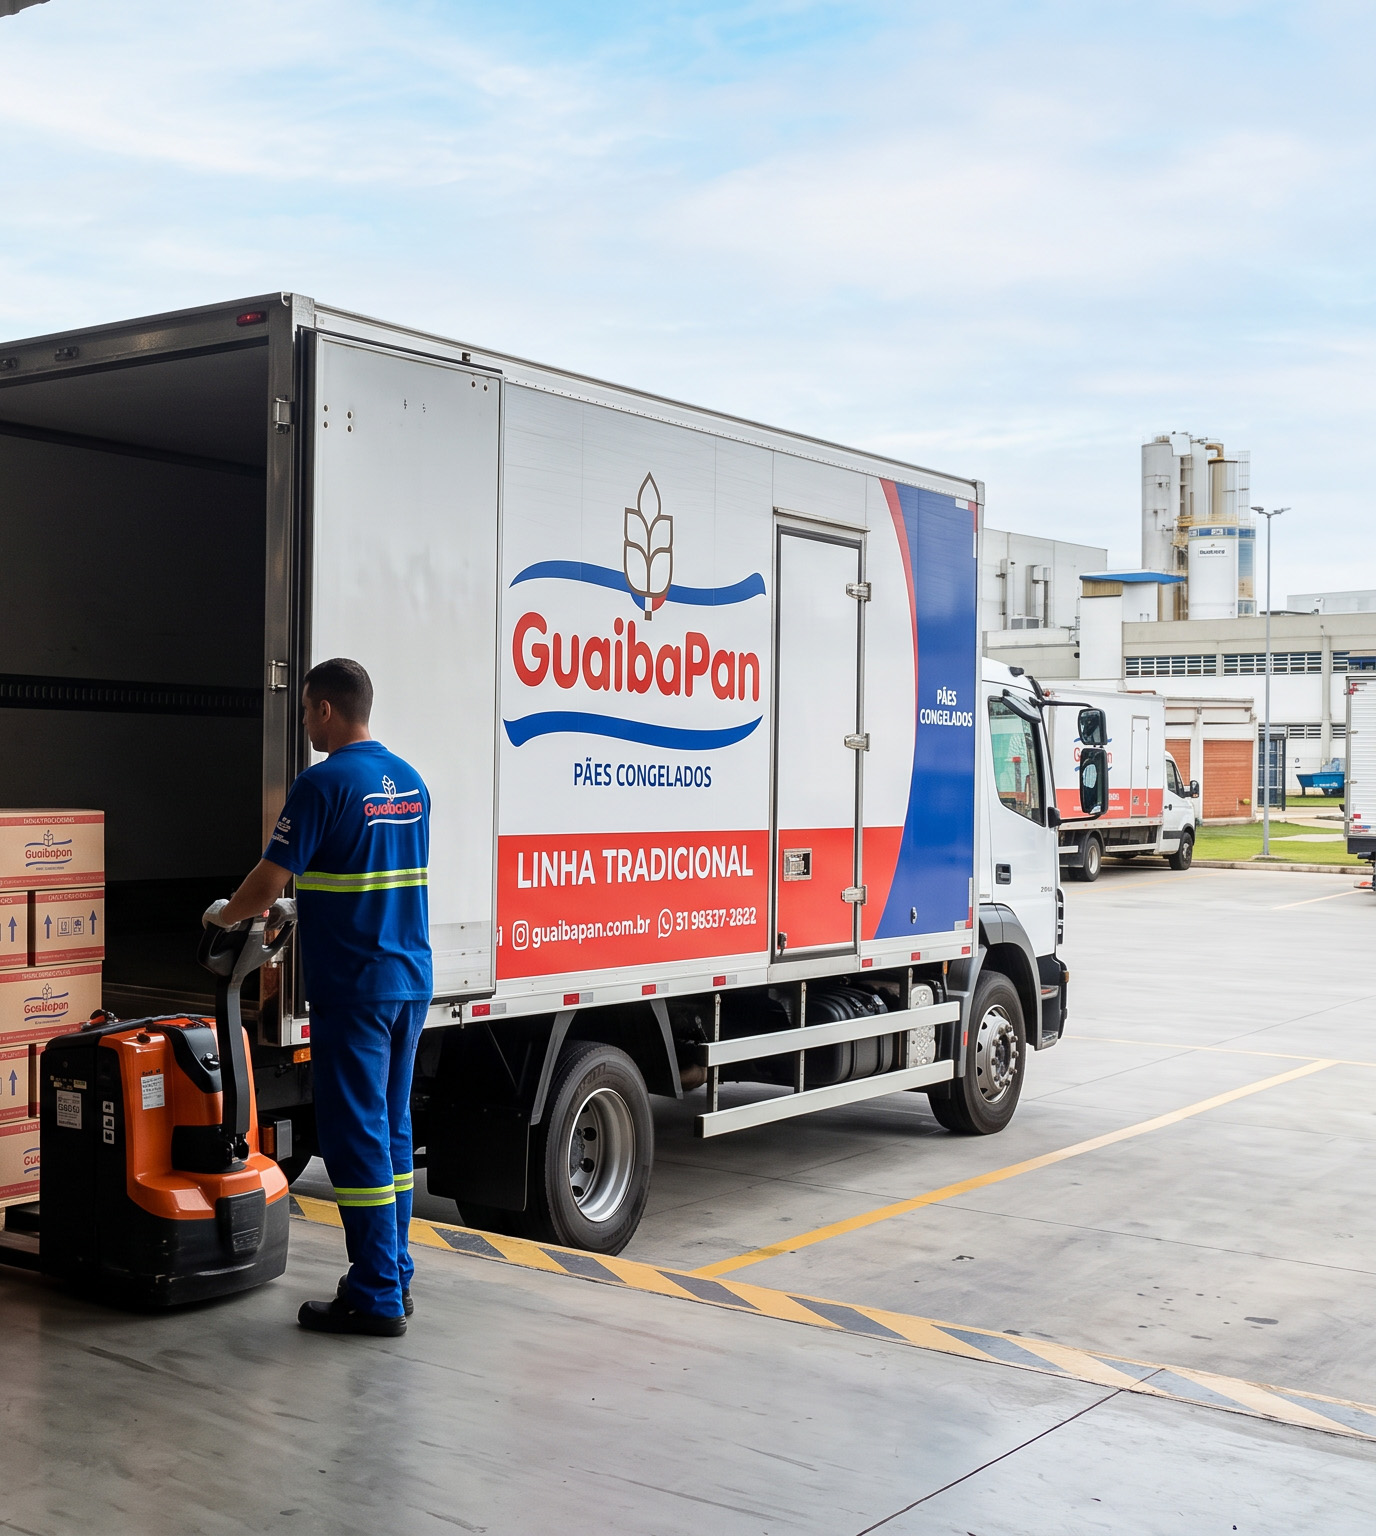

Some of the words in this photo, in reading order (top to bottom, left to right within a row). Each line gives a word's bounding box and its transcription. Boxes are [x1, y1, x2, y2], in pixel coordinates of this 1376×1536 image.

[511, 611, 760, 702] GuaibaPan
[936, 686, 957, 706] PÃES
[919, 708, 973, 727] CONGELADOS
[573, 757, 612, 787] PÃES
[616, 764, 712, 788] CONGELADOS
[517, 850, 596, 889] LINHA
[602, 845, 754, 884] TRADICIONAL
[532, 915, 651, 948] guaibapan.com.br
[675, 911, 689, 931] 31
